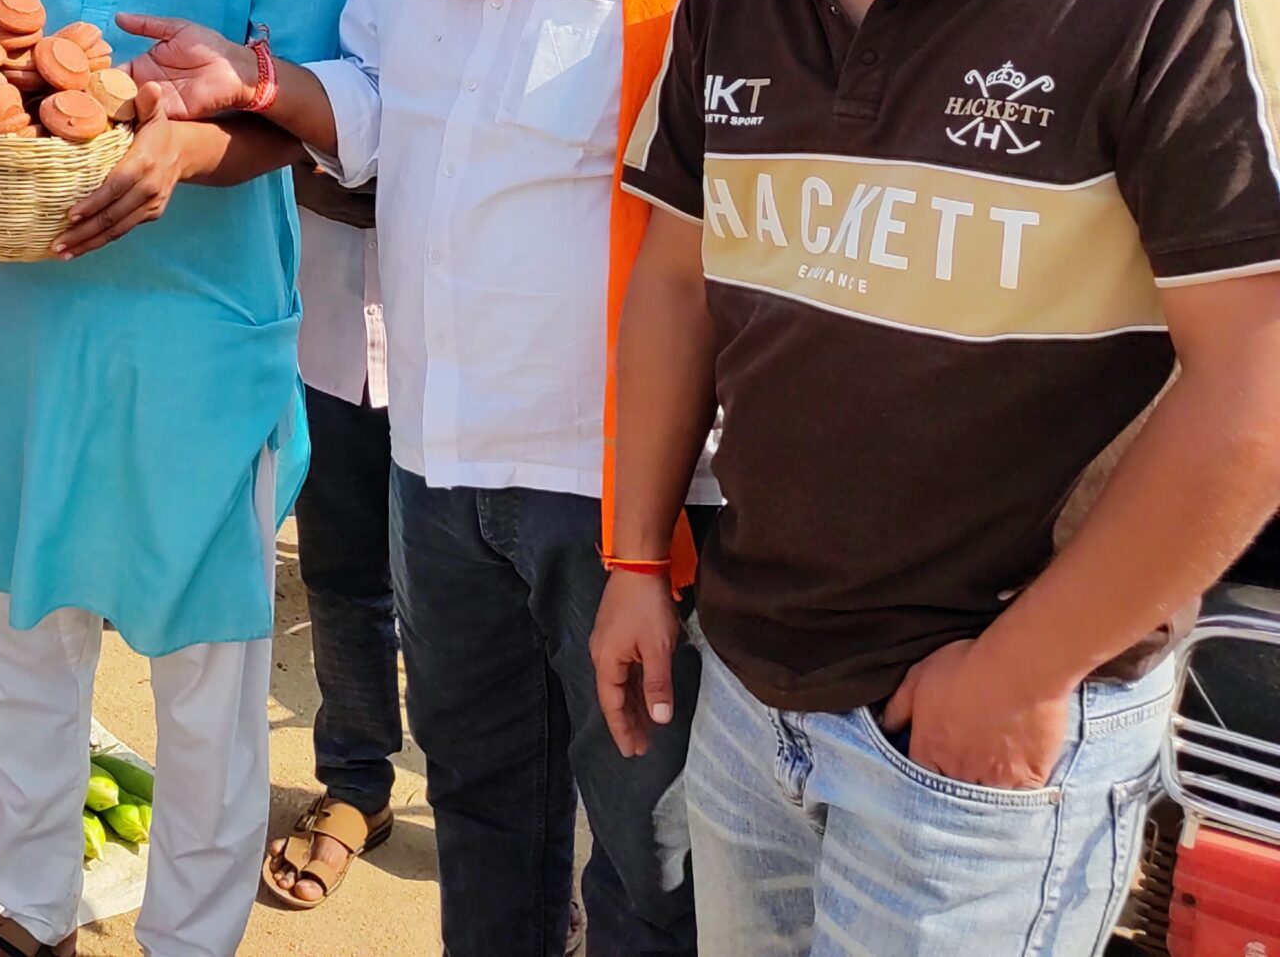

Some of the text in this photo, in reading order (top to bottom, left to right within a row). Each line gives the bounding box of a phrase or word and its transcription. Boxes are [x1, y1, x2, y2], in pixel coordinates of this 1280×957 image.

[729, 115, 765, 127] SPORT
[944, 96, 1055, 128] HACKETT
[973, 121, 1002, 151] H
[703, 172, 1040, 290] HACKETT
